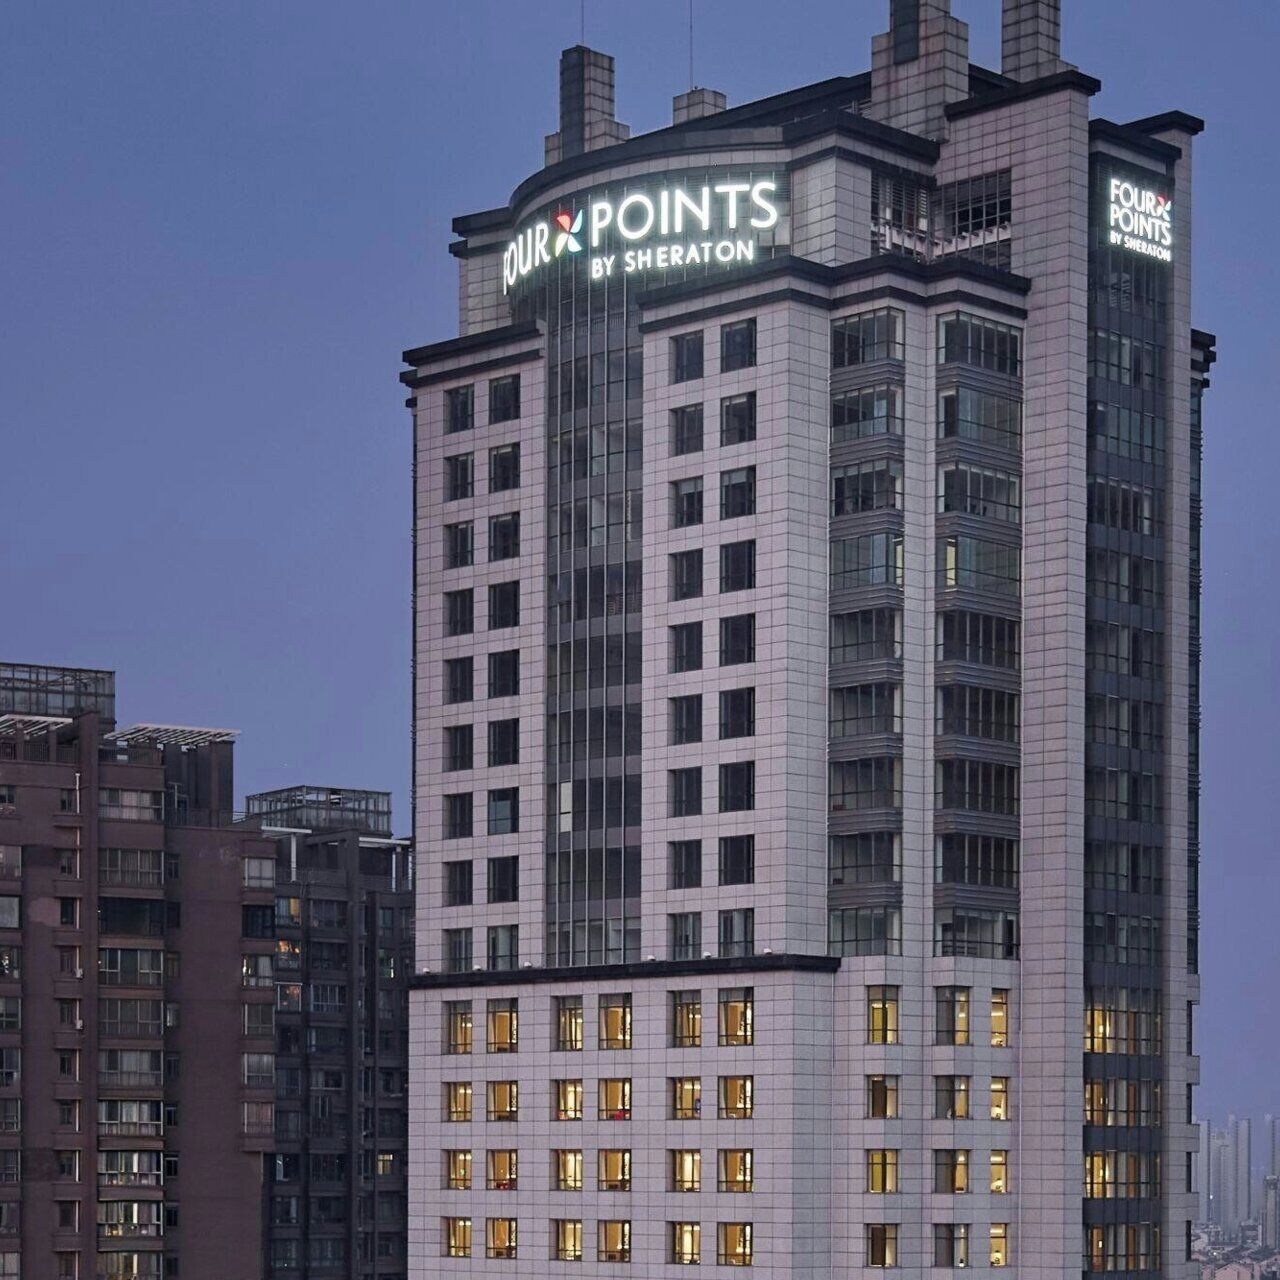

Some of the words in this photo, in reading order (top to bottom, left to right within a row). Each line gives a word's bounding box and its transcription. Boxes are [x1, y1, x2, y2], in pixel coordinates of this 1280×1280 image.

[1111, 179, 1158, 216] FOUR
[503, 223, 551, 295] FOUR
[591, 182, 777, 247] POINTS
[1110, 203, 1171, 246] POINTS
[591, 255, 616, 279] BY
[625, 240, 754, 271] SHERATON
[1110, 230, 1122, 245] BY
[1124, 235, 1171, 262] SHERATON
